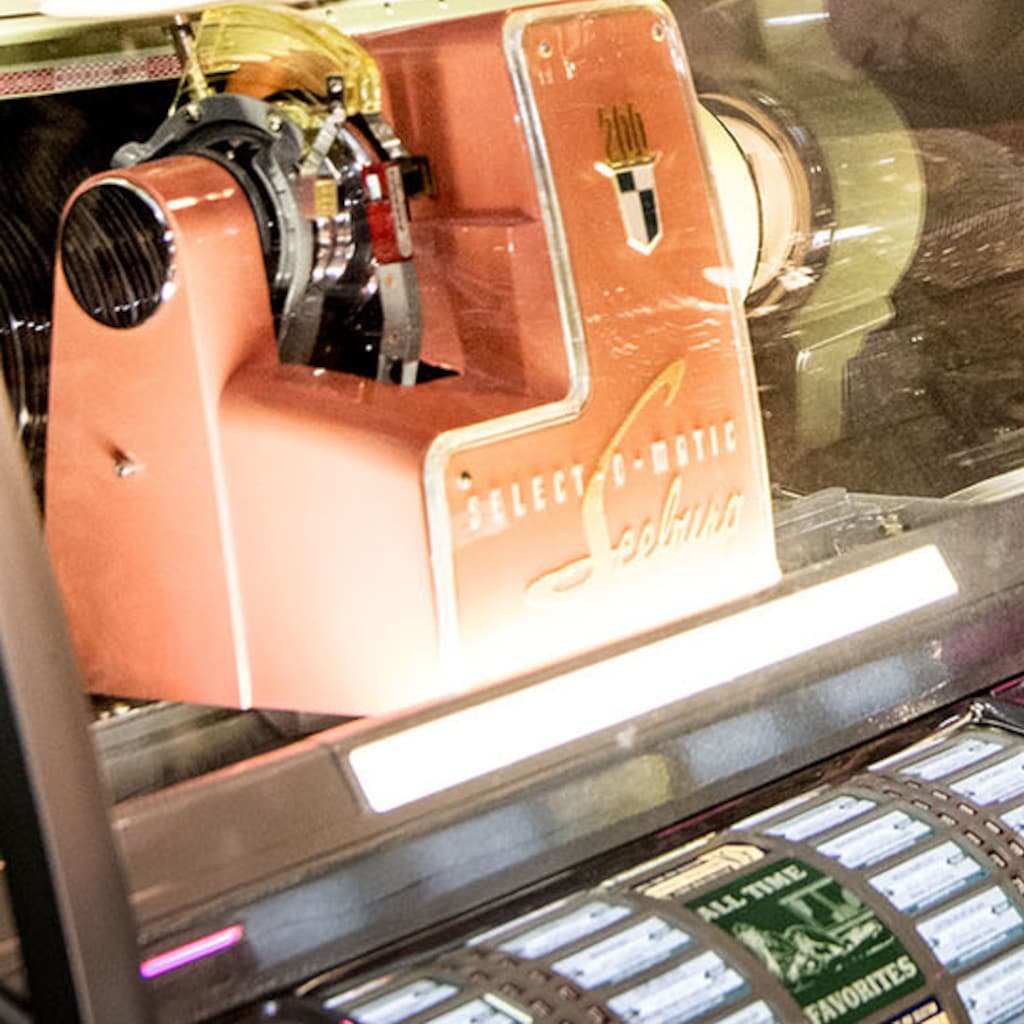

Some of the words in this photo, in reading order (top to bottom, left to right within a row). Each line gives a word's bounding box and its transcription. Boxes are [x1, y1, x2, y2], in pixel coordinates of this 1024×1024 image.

[697, 887, 748, 923] ALL
[740, 863, 808, 901] TIME
[802, 954, 918, 1024] FAVORITES
